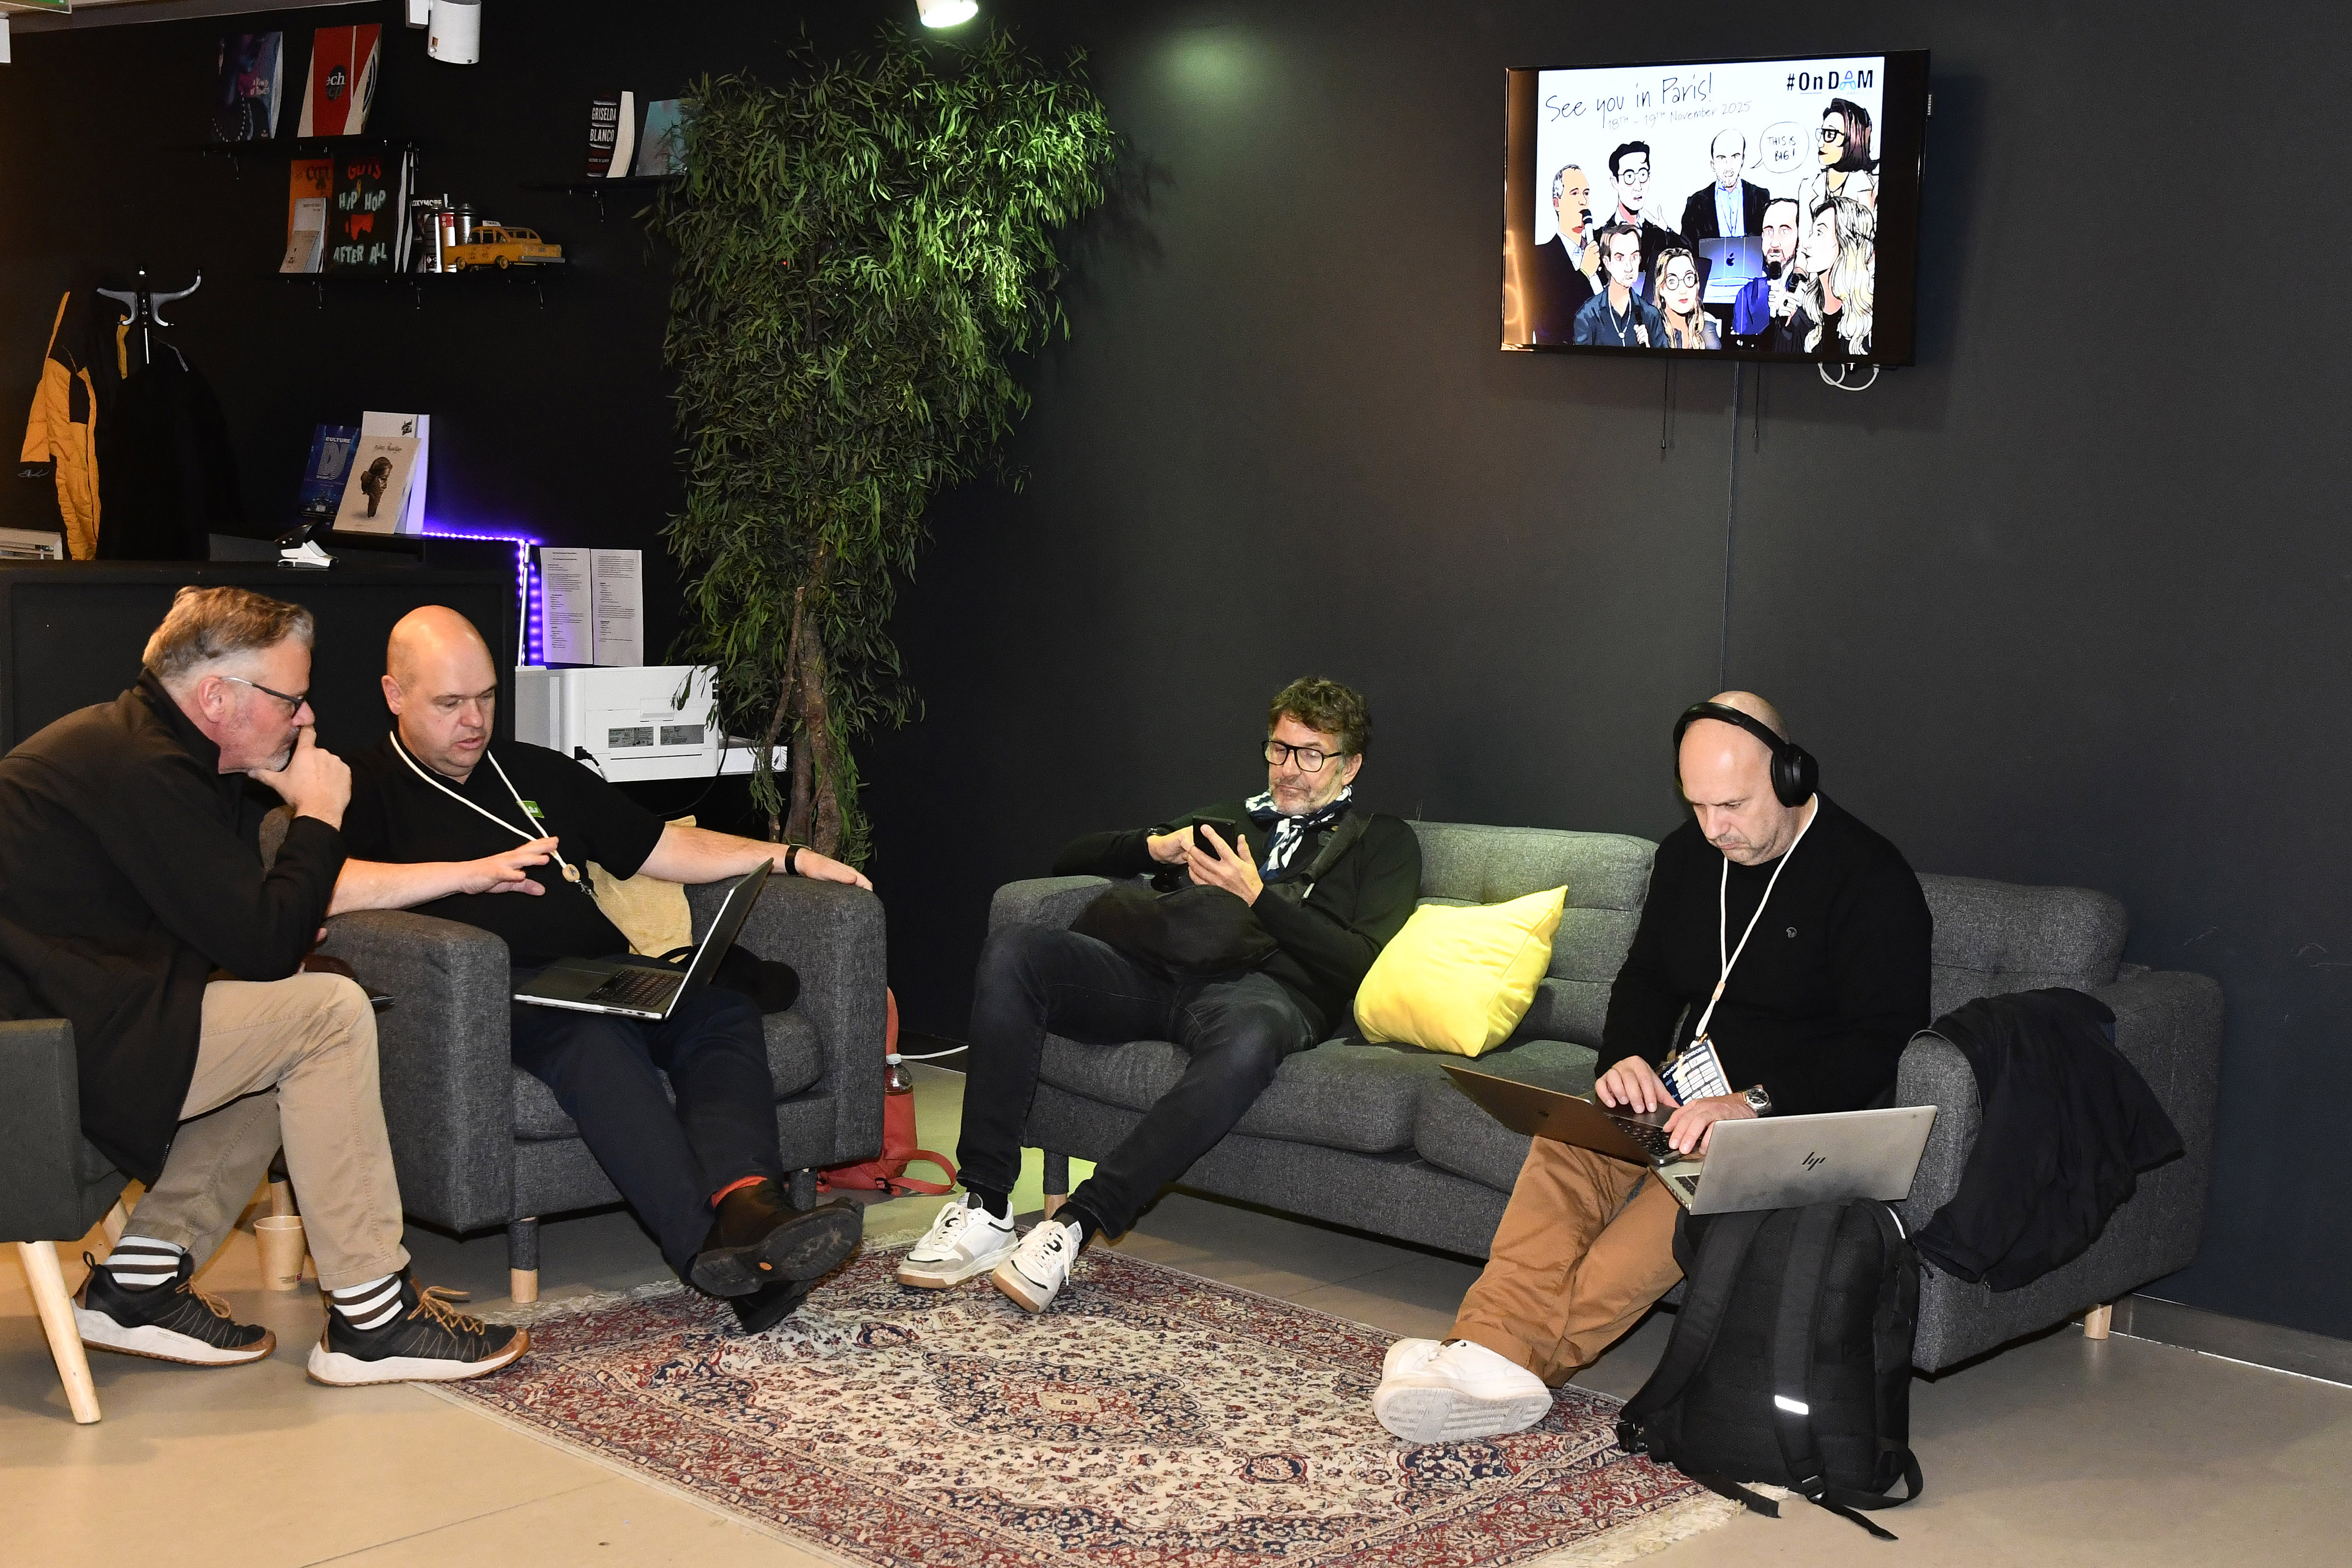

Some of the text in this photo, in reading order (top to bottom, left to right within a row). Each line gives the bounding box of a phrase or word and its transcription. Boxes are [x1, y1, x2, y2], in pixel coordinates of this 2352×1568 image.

[1546, 72, 1712, 128] See you in Paris!
[592, 107, 616, 121] GRISELDA
[1671, 107, 1717, 122] November
[1722, 101, 1752, 115] 2025
[590, 129, 614, 142] BLANCO
[1767, 136, 1796, 146] THIS IS
[348, 158, 382, 180] GUTS
[339, 190, 386, 211] HIP HOP
[334, 242, 388, 265] AFTER ALL
[1802, 1152, 1826, 1171] hp
